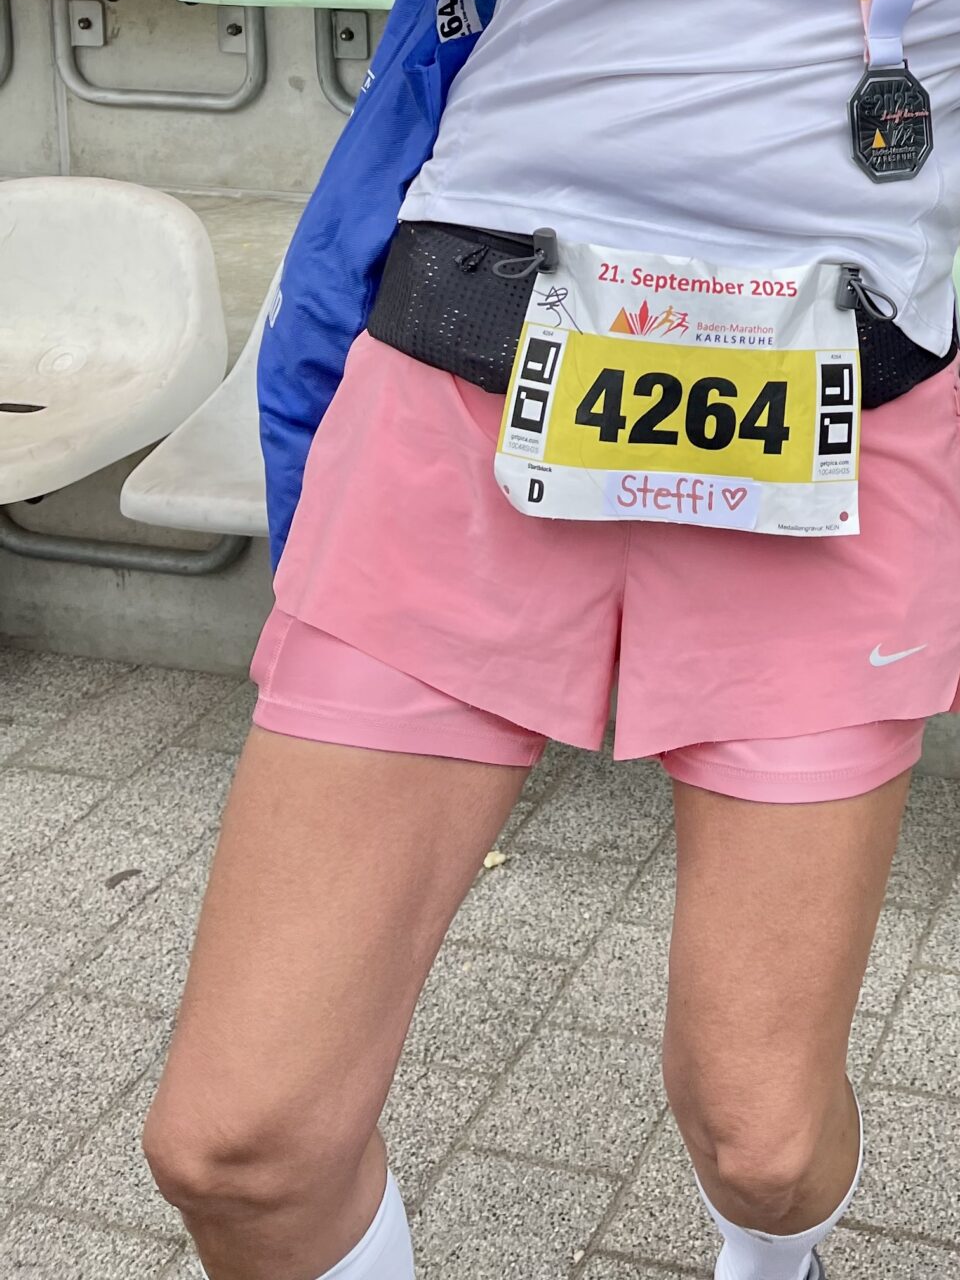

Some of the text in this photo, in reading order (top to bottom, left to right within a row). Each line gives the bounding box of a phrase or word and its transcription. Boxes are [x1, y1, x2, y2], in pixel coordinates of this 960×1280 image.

[598, 263, 798, 297] 21. September 2025
[695, 333, 774, 346] KARLSRUHE
[696, 322, 774, 335] Baden-Marathon
[574, 367, 790, 455] 4264
[527, 463, 553, 473] Startblock
[527, 478, 545, 504] D
[616, 474, 714, 514] Steffi
